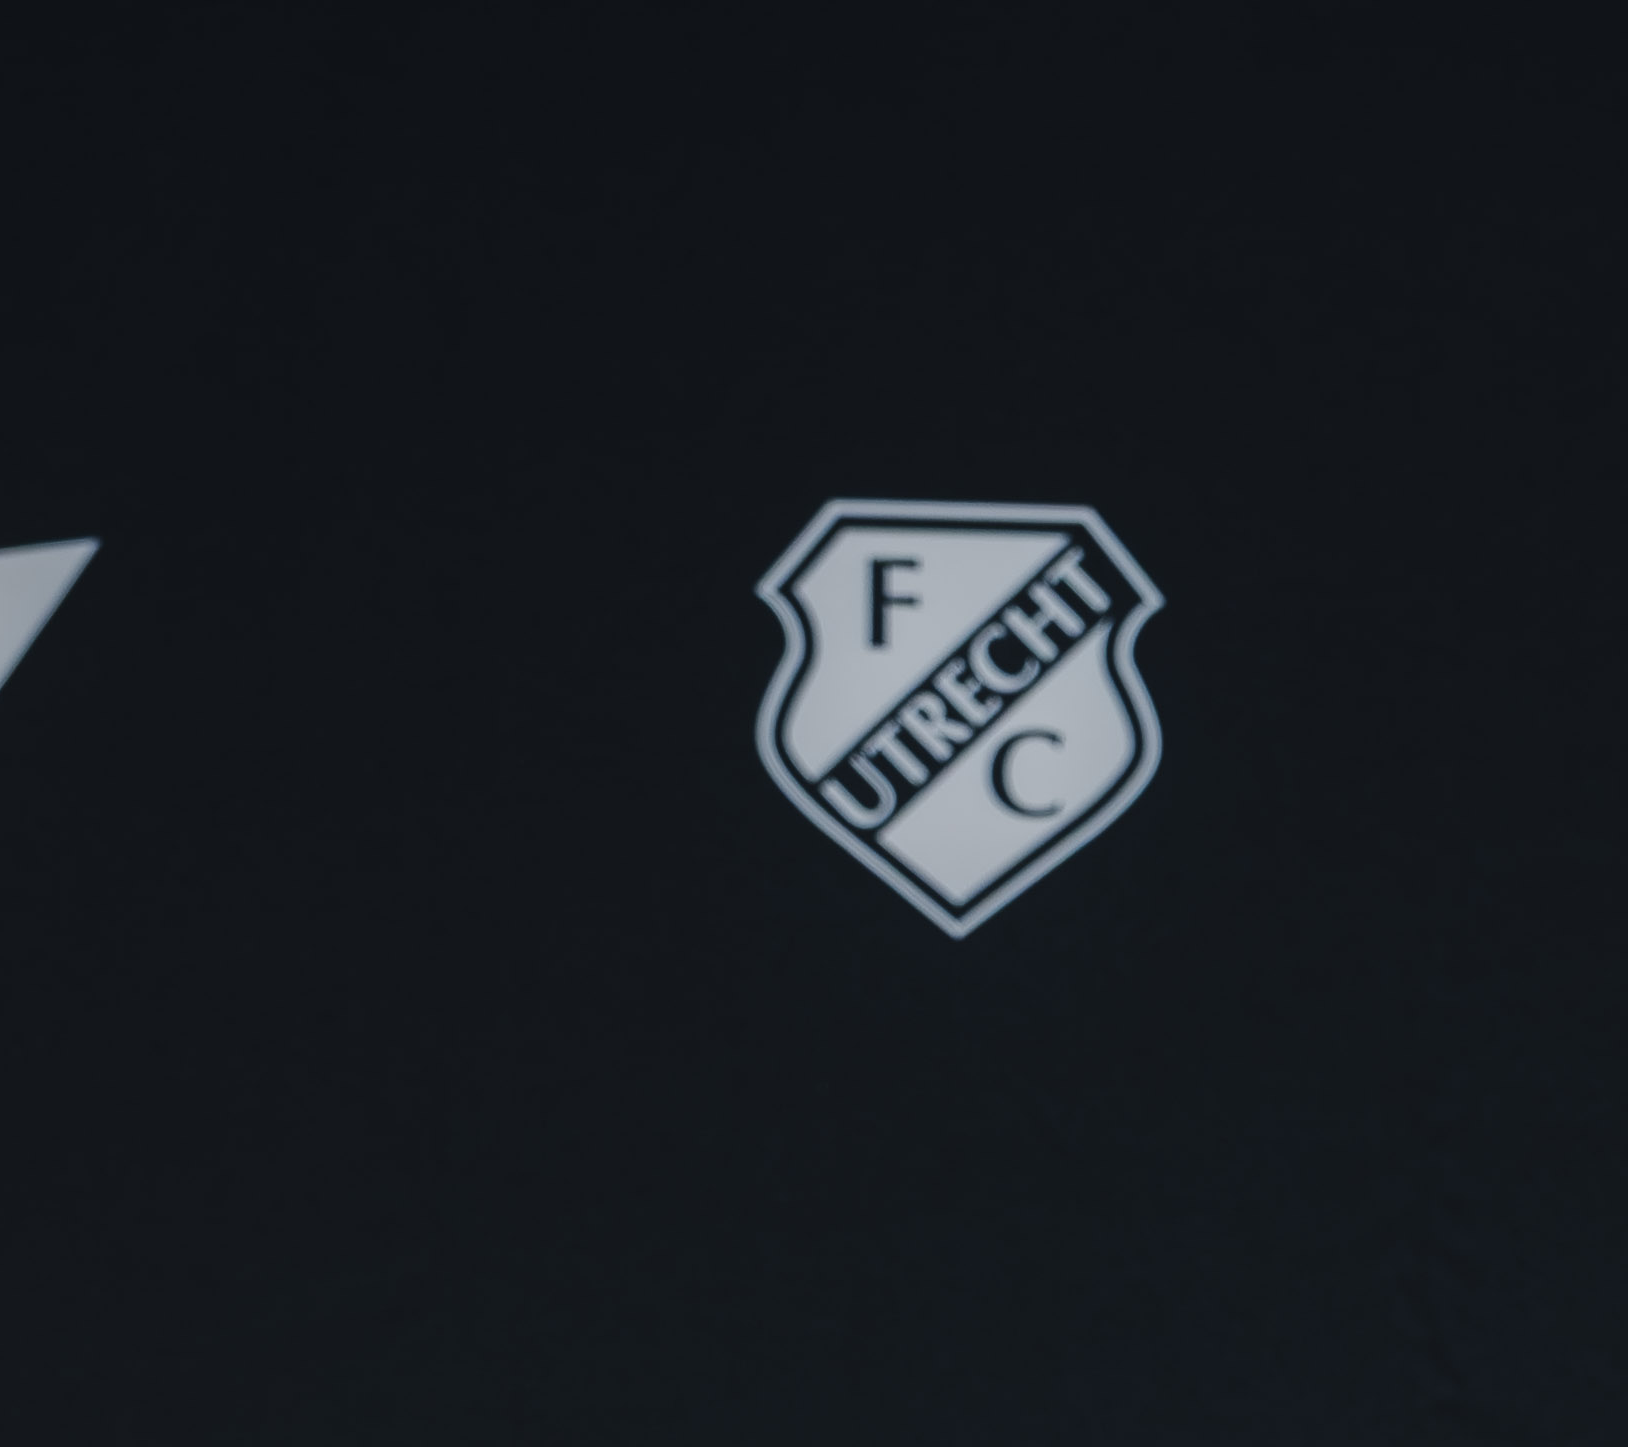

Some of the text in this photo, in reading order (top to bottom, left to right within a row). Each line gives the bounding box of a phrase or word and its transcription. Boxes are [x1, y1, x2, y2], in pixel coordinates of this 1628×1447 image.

[868, 556, 922, 650] F
[816, 545, 1112, 831] UTRECHT
[989, 727, 1064, 820] C
